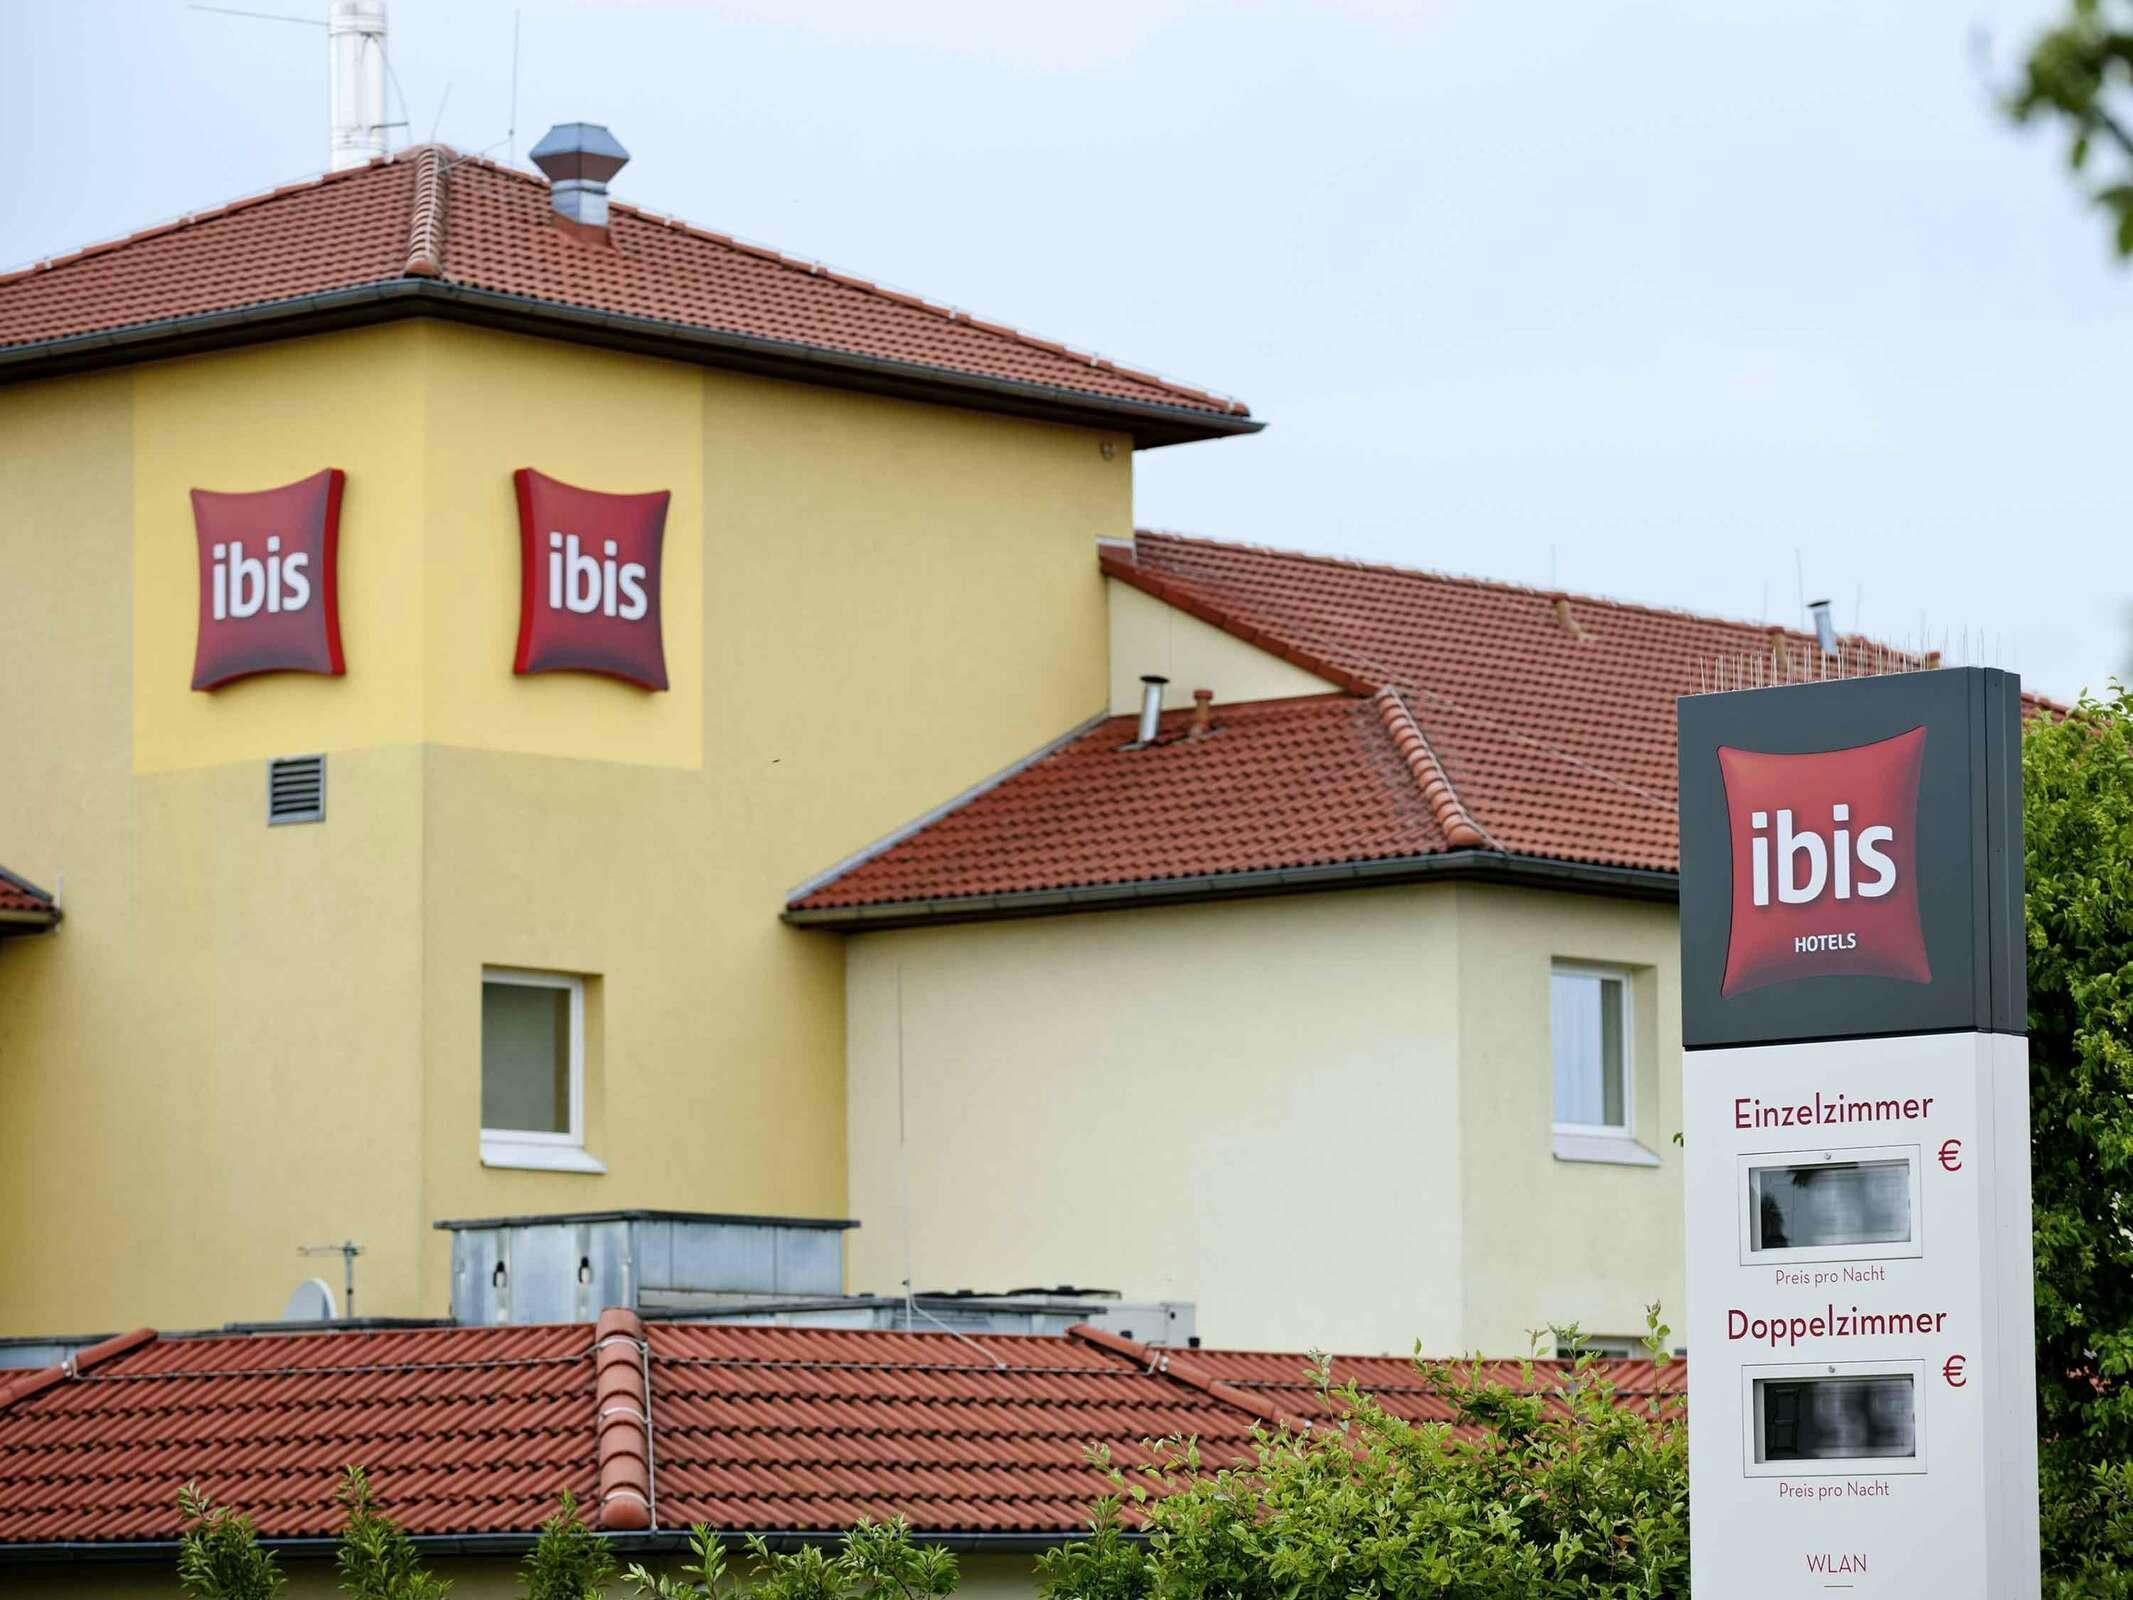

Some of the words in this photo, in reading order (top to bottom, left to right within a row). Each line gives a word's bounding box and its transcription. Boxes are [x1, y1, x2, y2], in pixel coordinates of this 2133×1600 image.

[213, 535, 311, 621] ibis
[548, 531, 648, 621] ibis
[1751, 803, 1897, 906] ibis
[1794, 932, 1857, 953] HOTELS
[1735, 1091, 1934, 1129] Einzelzimmer
[1937, 1138, 1963, 1172] €
[1775, 1269, 1811, 1285] Preis
[1814, 1271, 1839, 1288] pro
[1842, 1265, 1886, 1282] Nacht
[1727, 1303, 1947, 1347] Doppelzimmer
[1942, 1354, 1967, 1388] €
[1778, 1482, 1815, 1498] Preis
[1818, 1485, 1843, 1501] pro
[1847, 1480, 1890, 1497] Nacht
[1806, 1553, 1867, 1574] WLAN
